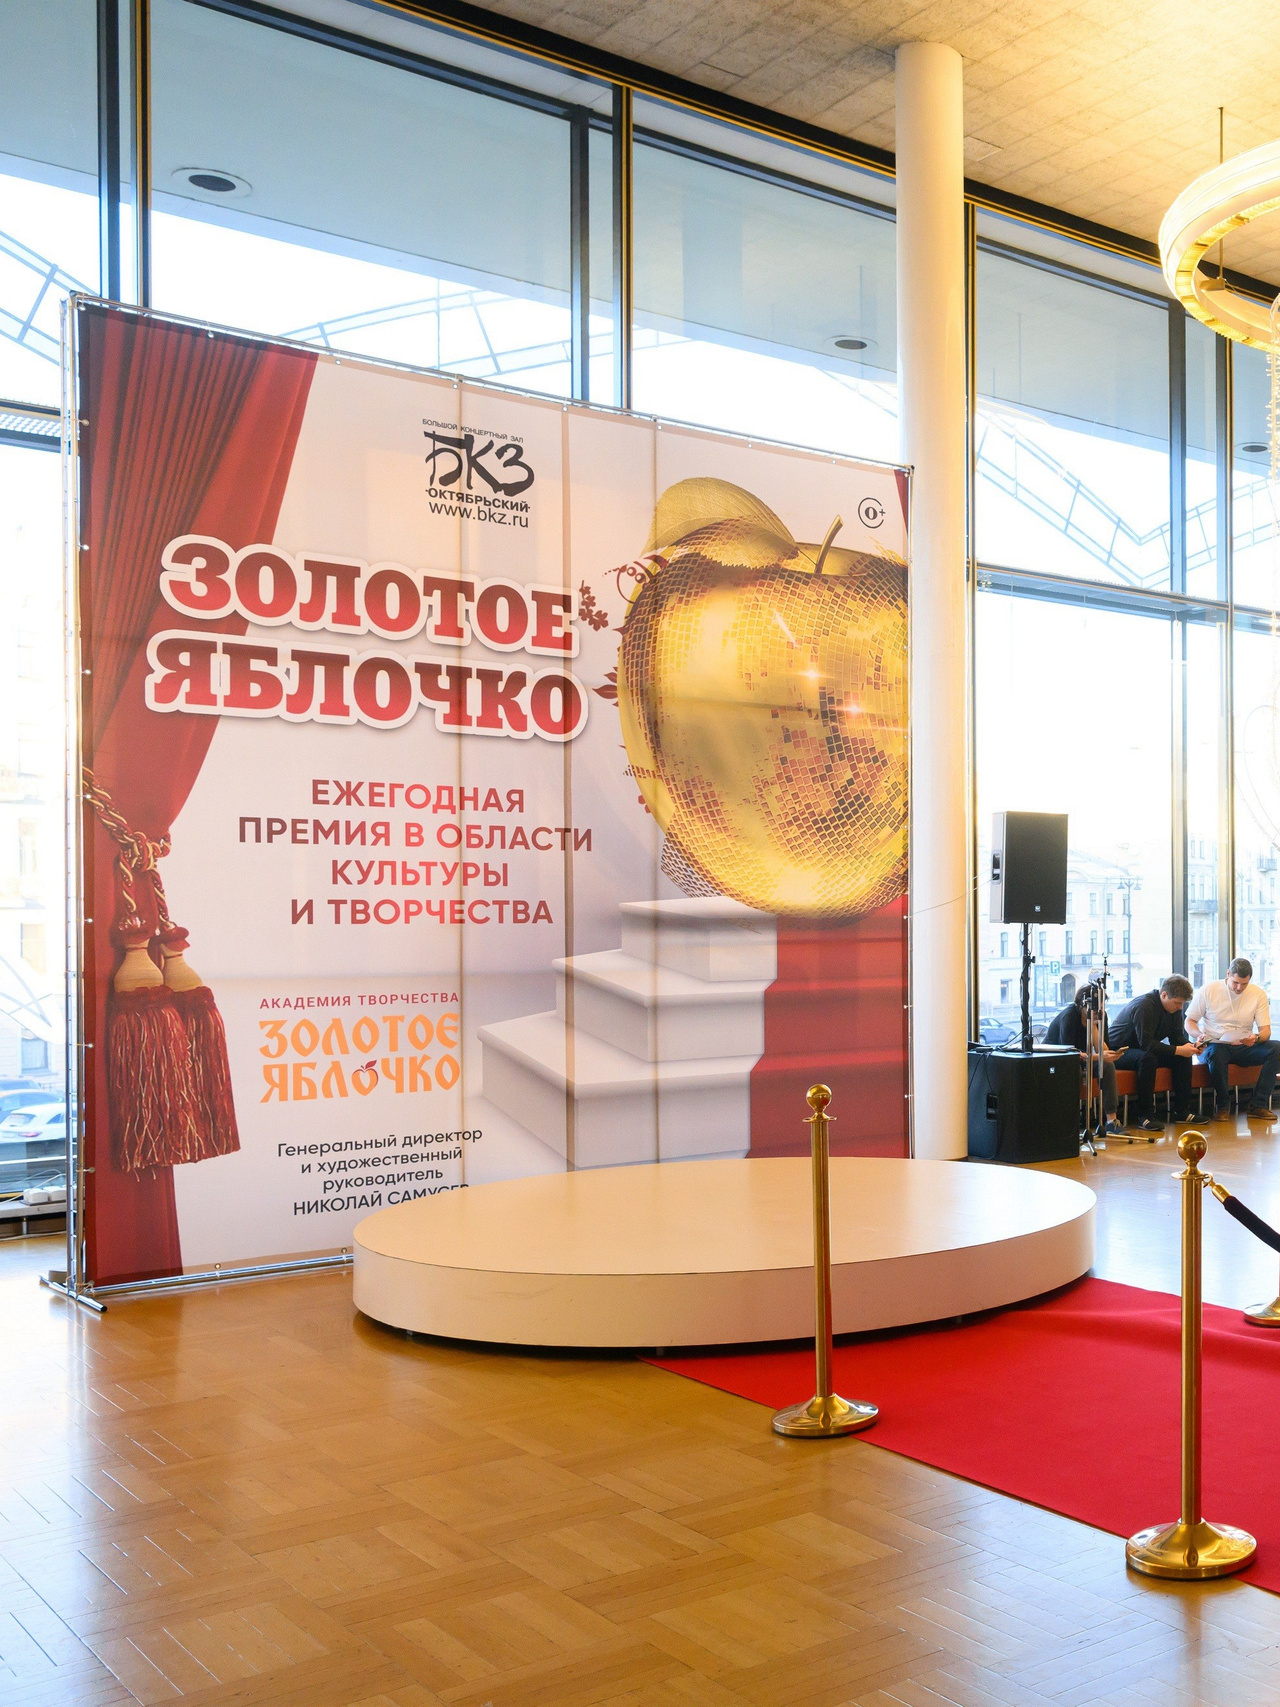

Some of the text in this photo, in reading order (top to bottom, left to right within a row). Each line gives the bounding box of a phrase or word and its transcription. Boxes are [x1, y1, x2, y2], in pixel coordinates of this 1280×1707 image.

[422, 418, 524, 443] БОЛЬШОЙ КОНЦЕРТНЫЙ ЗАЛ
[423, 430, 535, 497] БКЗ
[428, 501, 529, 528] www.bkz.ru
[168, 541, 574, 652] ЗОЛОТОЕ
[153, 636, 583, 736] ЯБЛОЧКО
[311, 778, 525, 814] ЕЖЕГОДНАЯ
[238, 816, 593, 853] ПРЕМИЯ В ОБЛАСТИ
[331, 859, 509, 887] КУЛЬТУРЫ
[291, 898, 554, 925] И ТВОРЧЕСТВА
[259, 992, 459, 1011] АКАДЕМИЯ ТВОРЧЕСТВА
[258, 1012, 460, 1059] ЗОЛОТОЕ
[259, 1053, 461, 1103] ЯБЛОЧКО
[277, 1128, 483, 1158] Генеральный директор
[301, 1146, 463, 1175] и художественный
[323, 1168, 444, 1194] руководитель
[293, 1190, 383, 1216] НИКОЛАЙ
